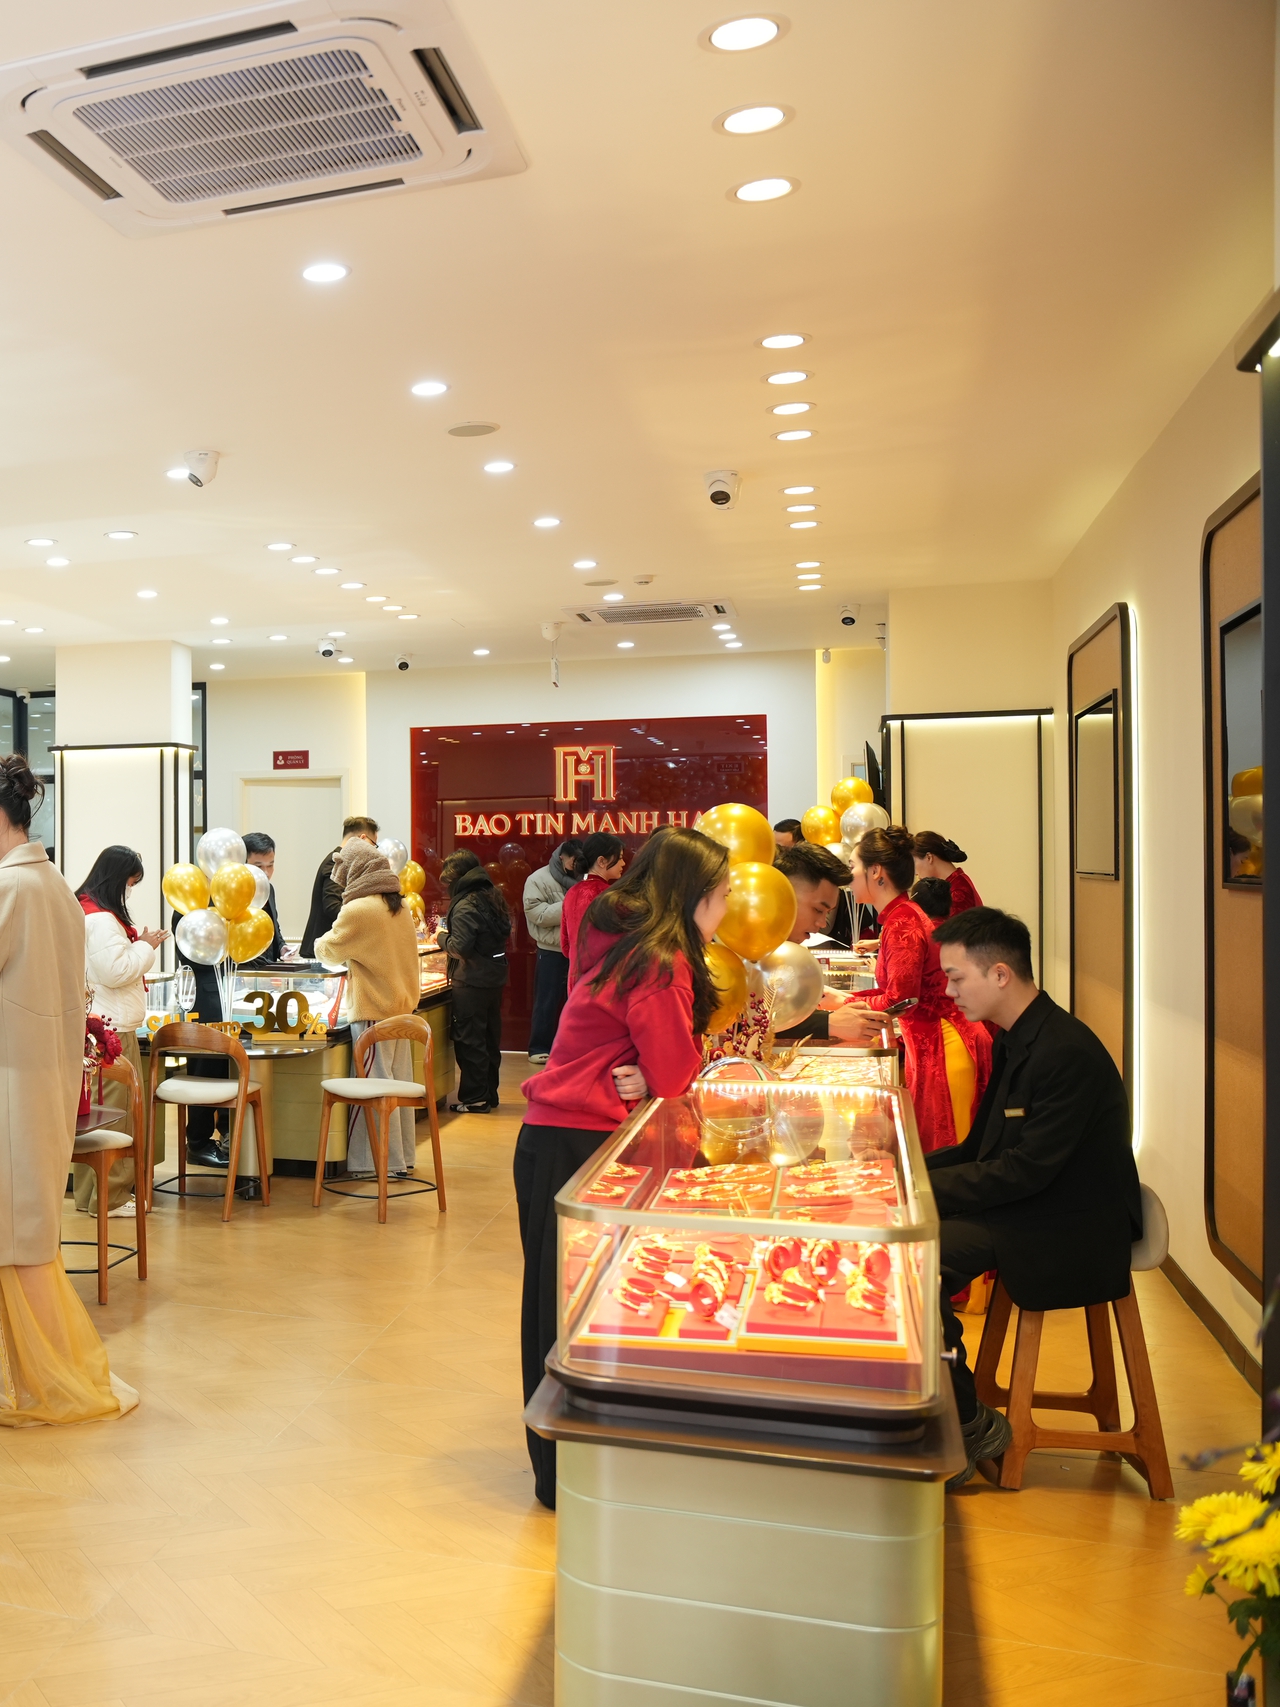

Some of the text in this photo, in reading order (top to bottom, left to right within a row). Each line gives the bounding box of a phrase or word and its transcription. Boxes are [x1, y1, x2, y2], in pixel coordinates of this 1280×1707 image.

[453, 814, 511, 836] BAO
[515, 812, 565, 835] TIN
[571, 811, 660, 835] MANH
[242, 991, 327, 1035] 30%
